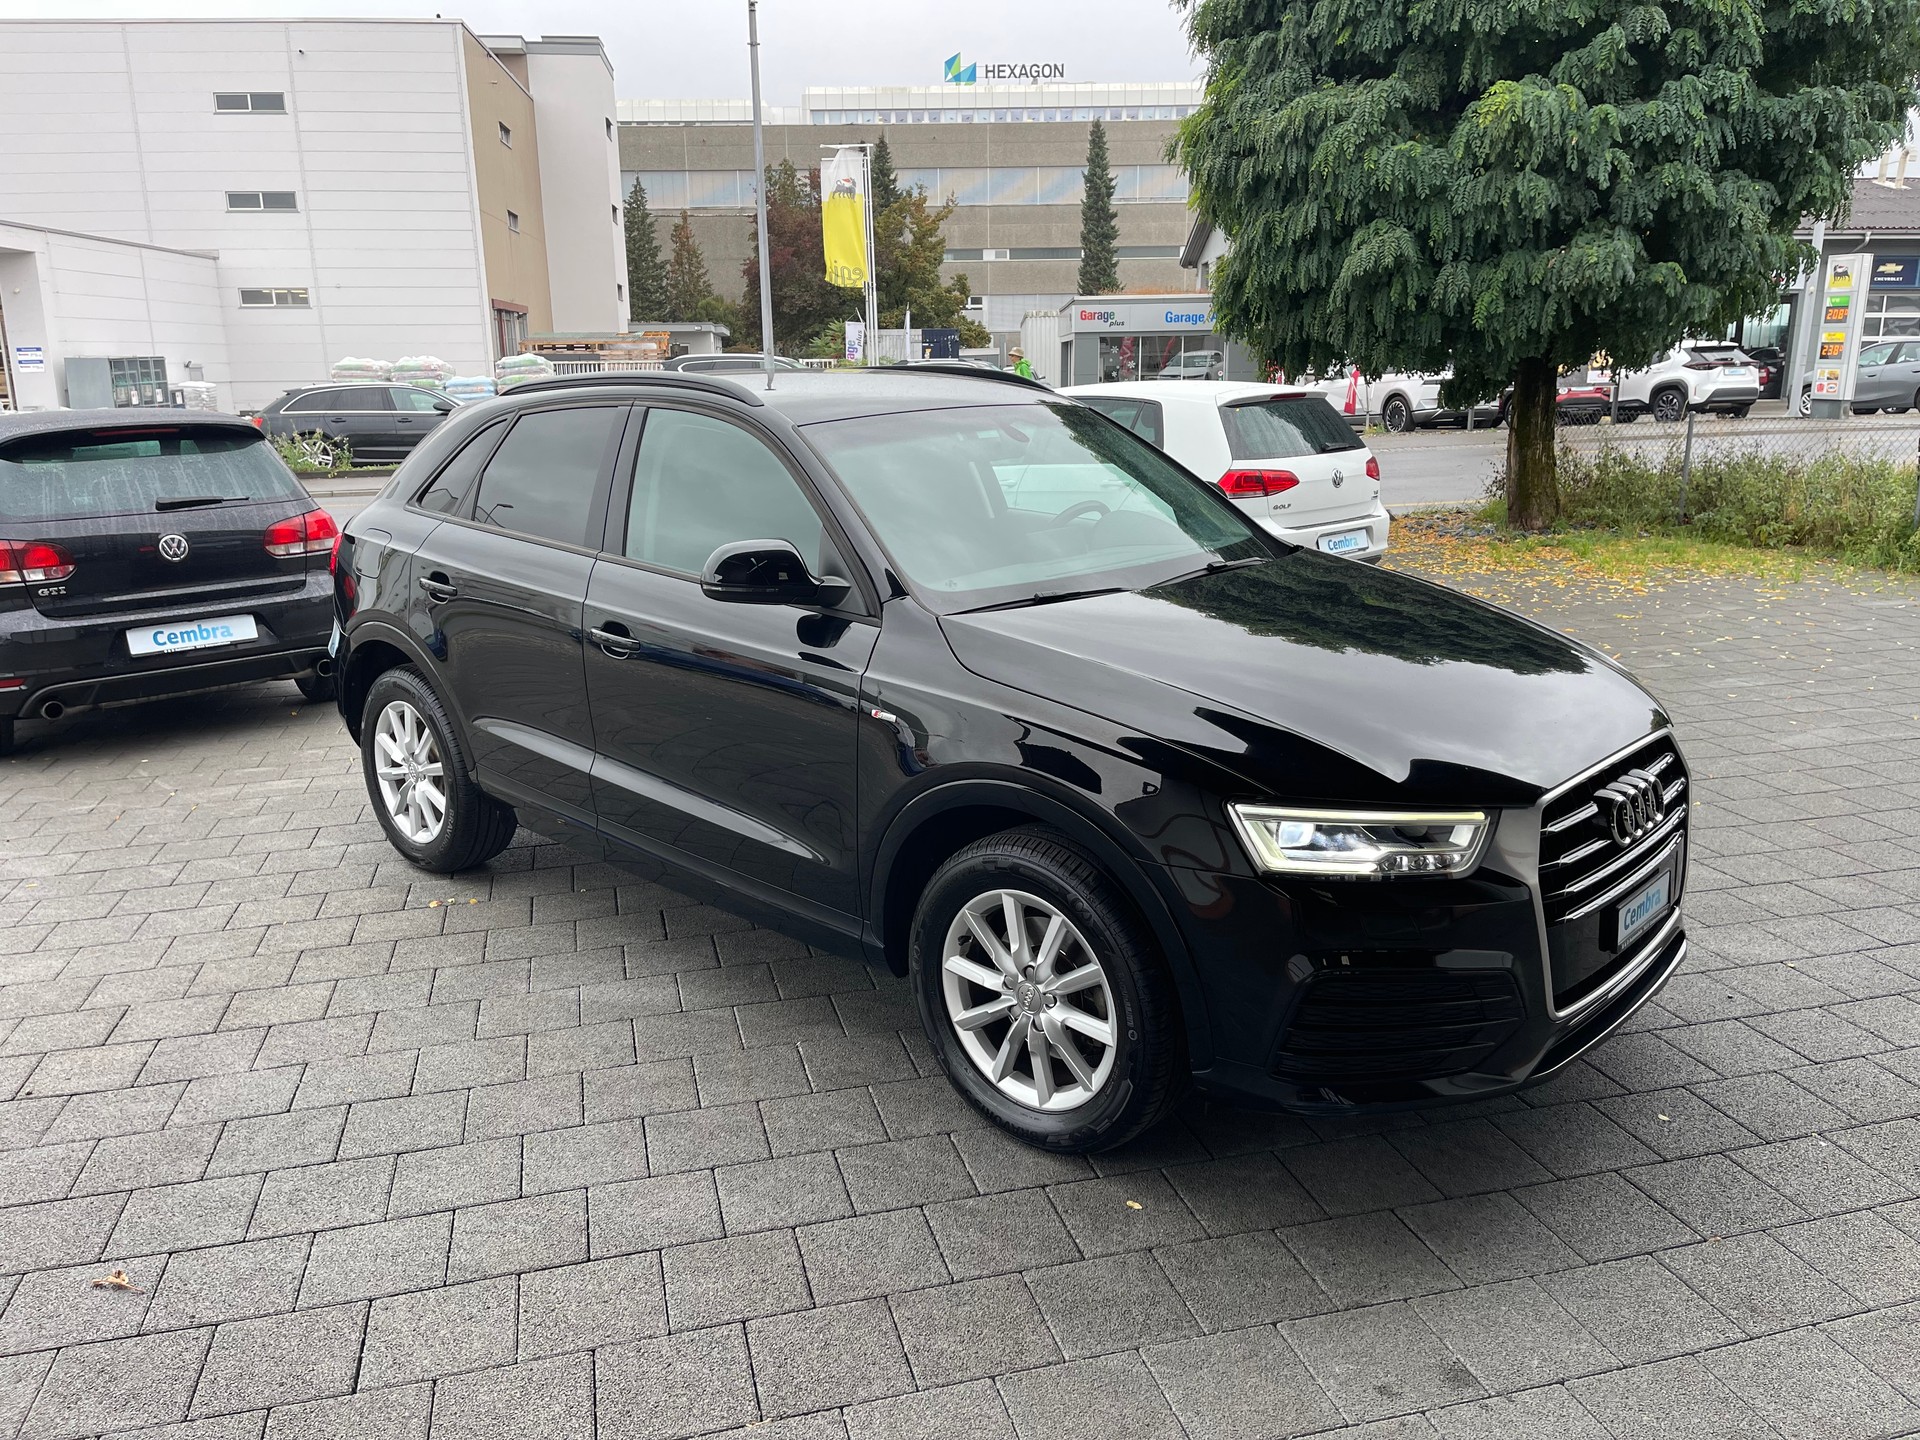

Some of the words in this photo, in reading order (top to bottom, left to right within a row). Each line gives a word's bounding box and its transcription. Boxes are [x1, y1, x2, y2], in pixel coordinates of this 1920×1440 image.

[985, 63, 1065, 79] HEXAGON
[1080, 310, 1115, 324] Garage
[1109, 320, 1125, 328] plus
[1165, 311, 1206, 325] Garage
[846, 340, 858, 360] age
[1327, 536, 1359, 551] Cembra
[38, 586, 67, 597] GTI
[152, 624, 233, 646] Cembra
[1624, 888, 1661, 931] Cembra
